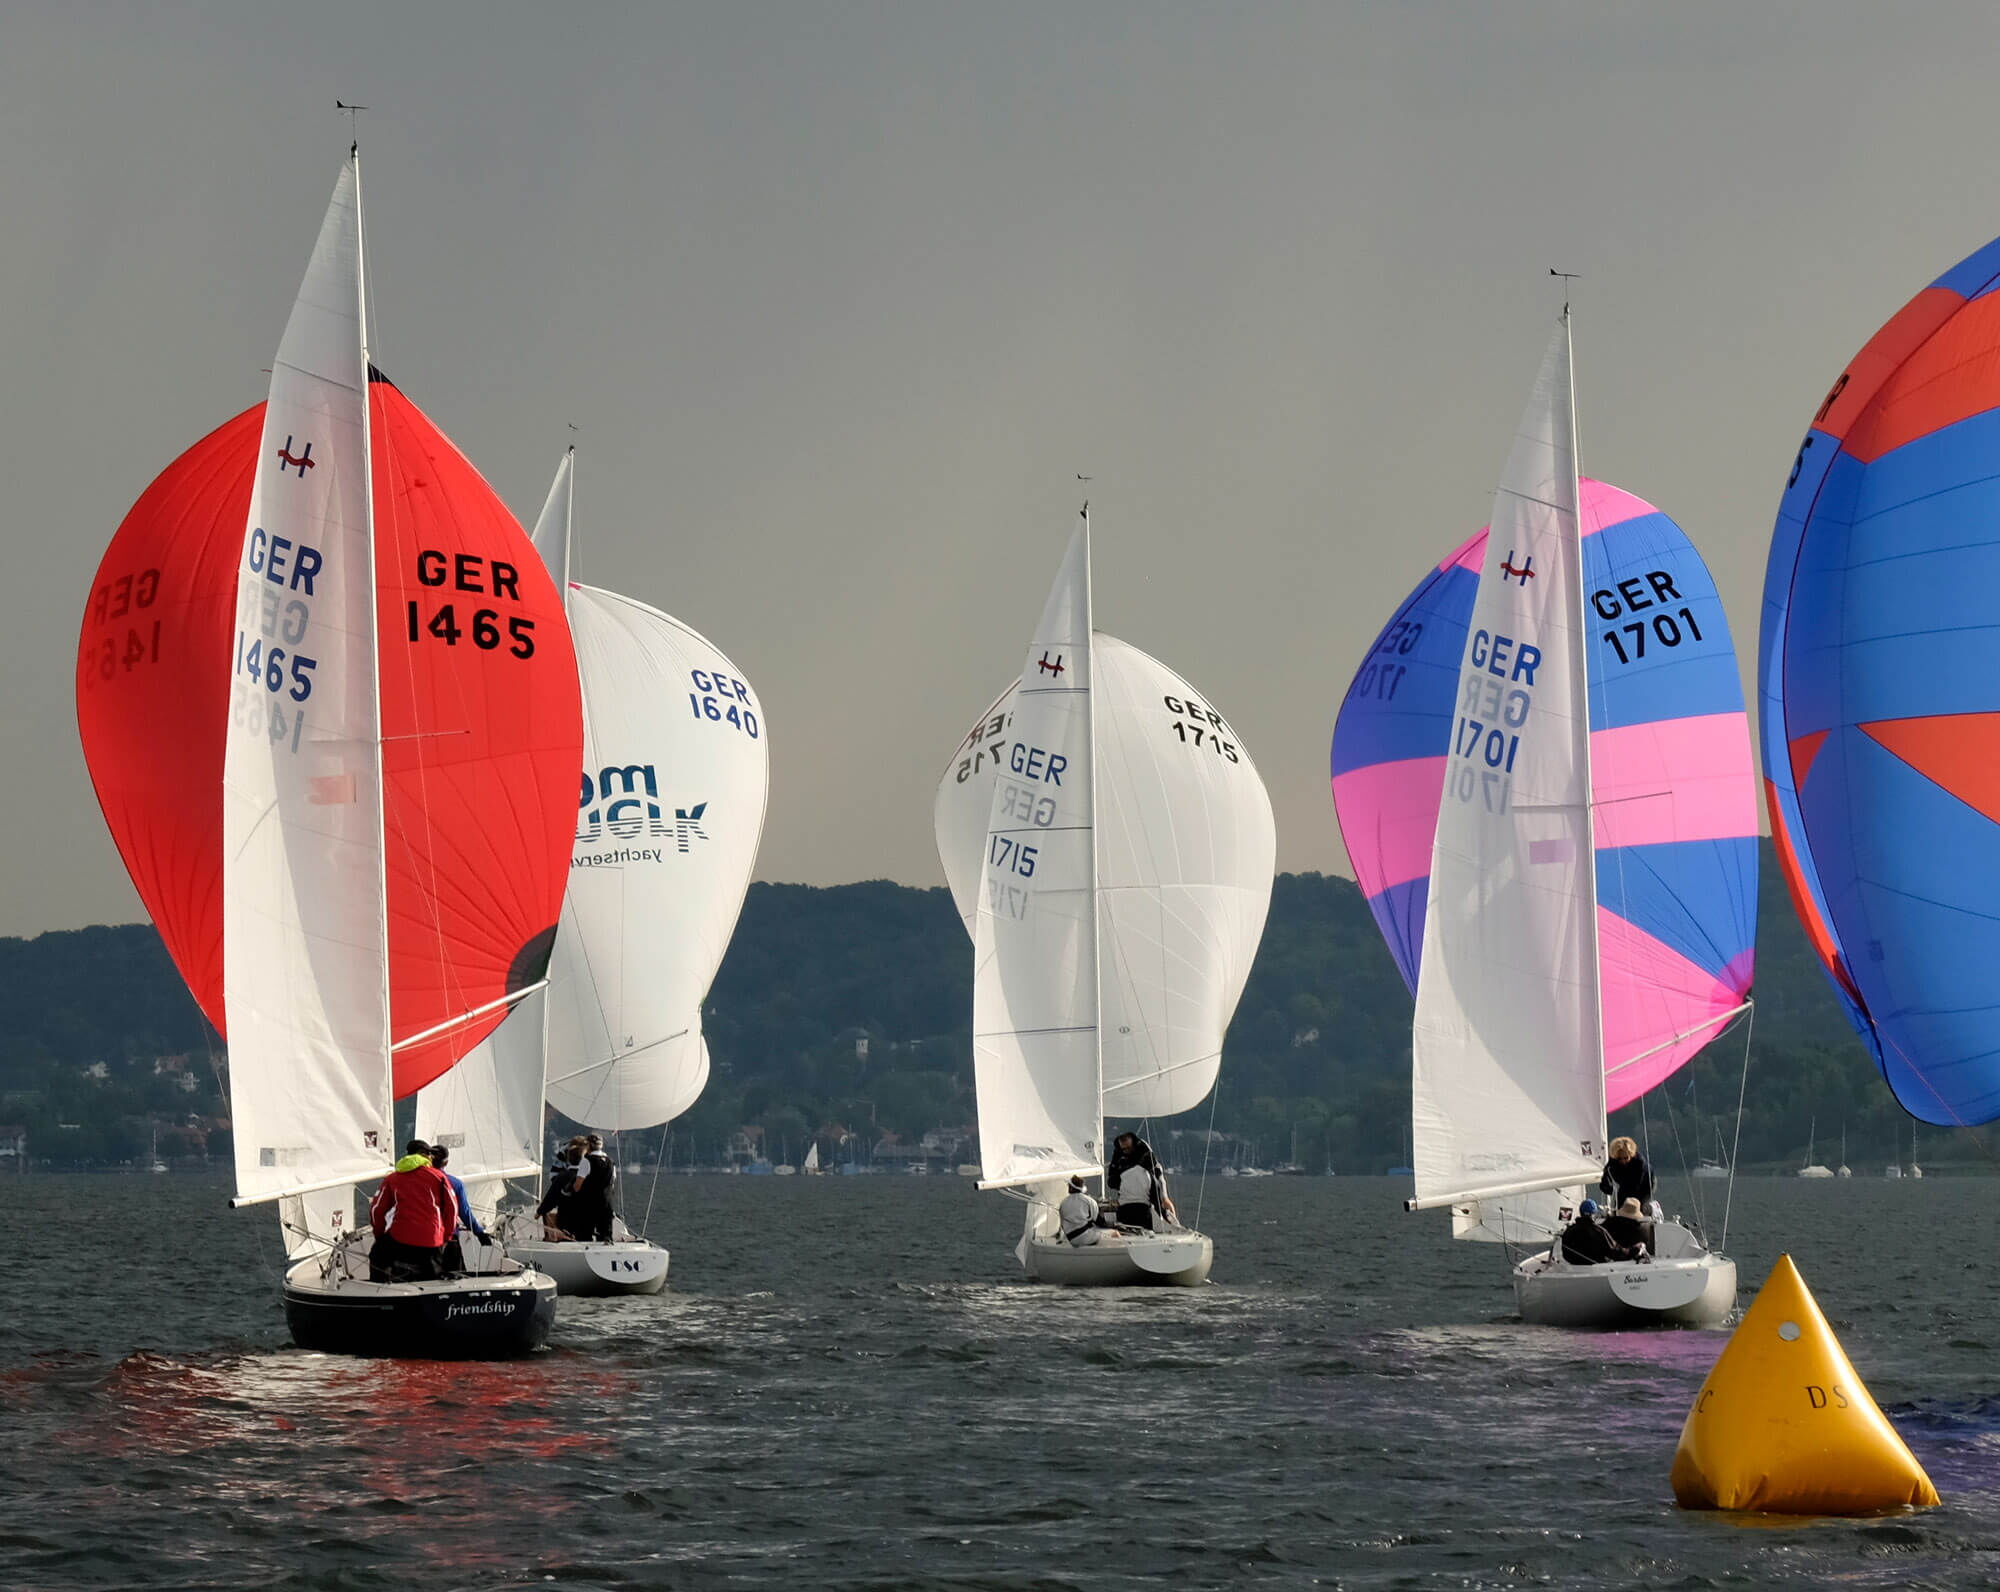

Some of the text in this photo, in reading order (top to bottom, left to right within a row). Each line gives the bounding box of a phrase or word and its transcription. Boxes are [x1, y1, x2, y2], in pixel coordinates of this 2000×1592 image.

[249, 528, 323, 596] GER
[417, 550, 519, 600] GER
[1591, 570, 1682, 621] GER
[408, 601, 535, 660] 1465
[1603, 607, 1703, 664] 1701
[237, 631, 317, 702] 1465
[1471, 629, 1541, 686] GER
[690, 669, 752, 706] GER
[689, 693, 759, 740] 1640
[1163, 695, 1225, 734] GER
[1010, 742, 1068, 786] GER
[1172, 721, 1239, 764] 1715
[1456, 717, 1520, 774] 1701
[990, 835, 1039, 878] 1715
[445, 1300, 516, 1321] friendship
